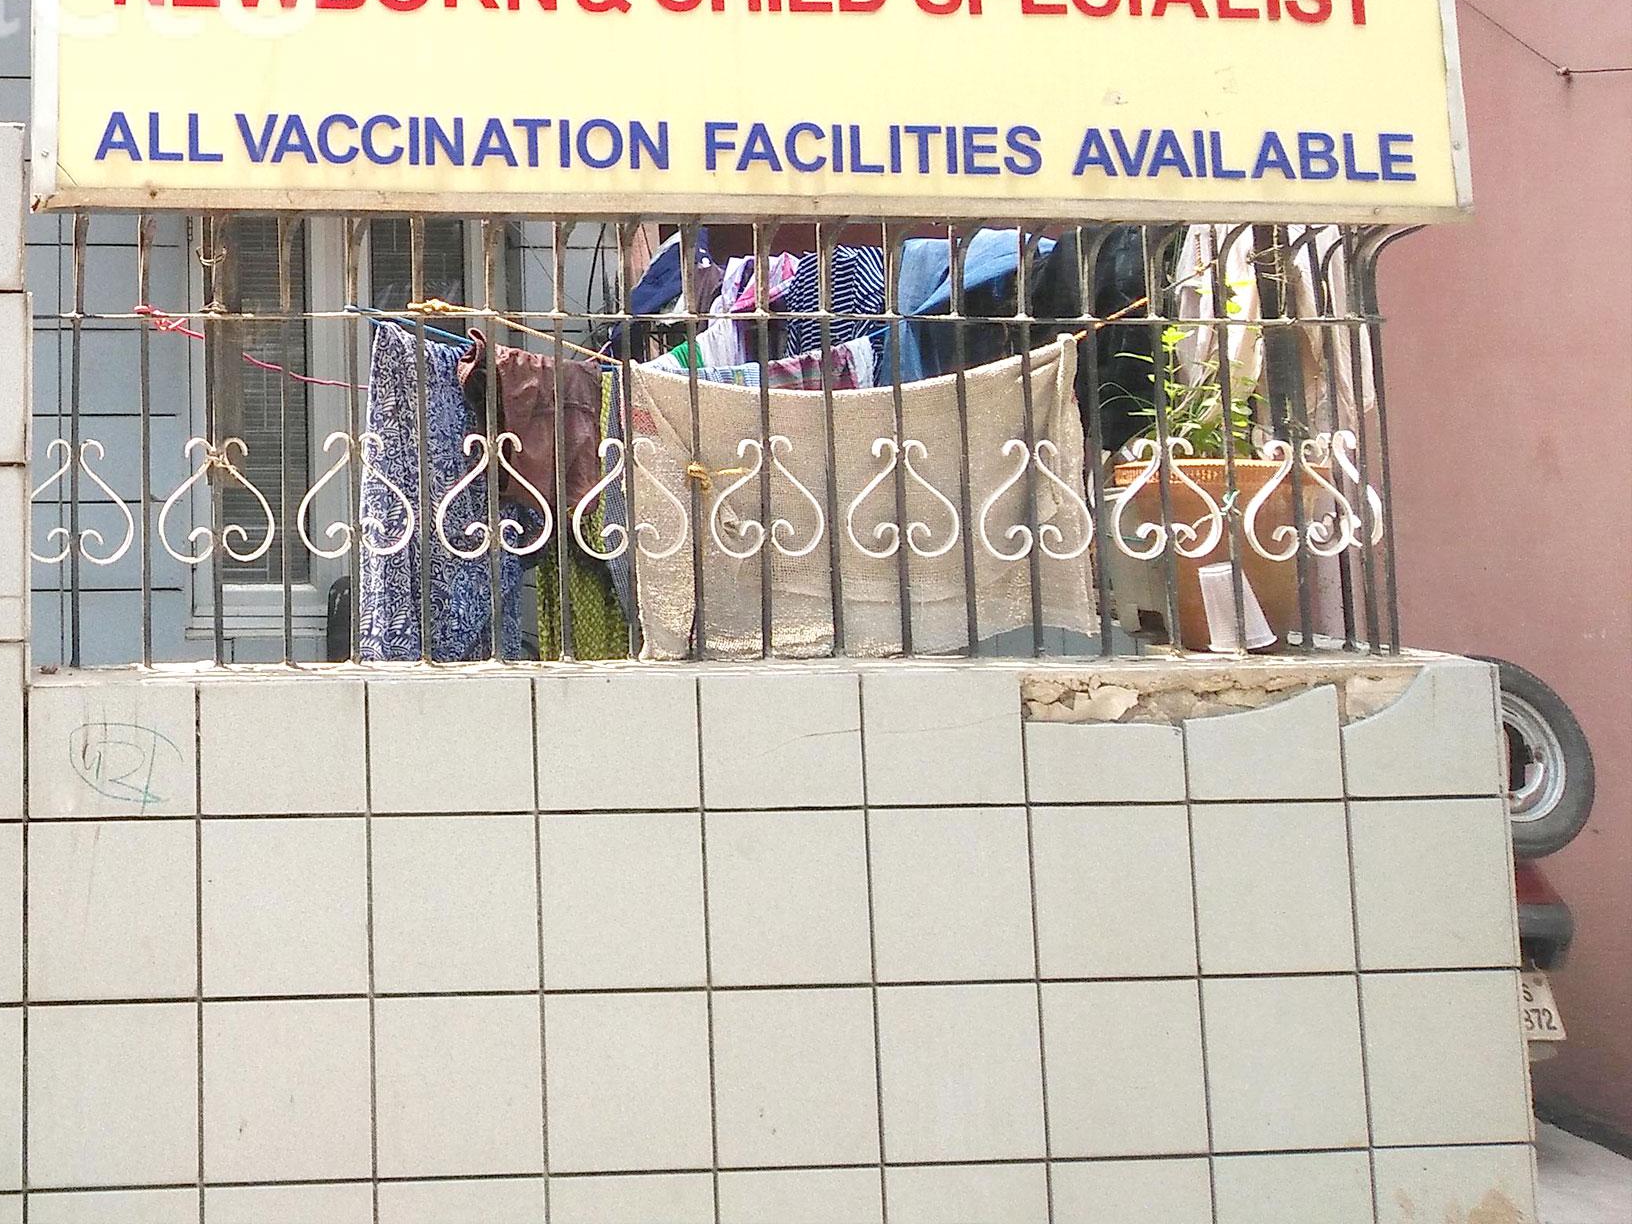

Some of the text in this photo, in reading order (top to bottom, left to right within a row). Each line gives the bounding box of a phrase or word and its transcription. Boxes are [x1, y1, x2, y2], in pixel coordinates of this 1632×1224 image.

[95, 110, 1416, 182] ALL VACCINATION FACILITIES AVAILABLE
